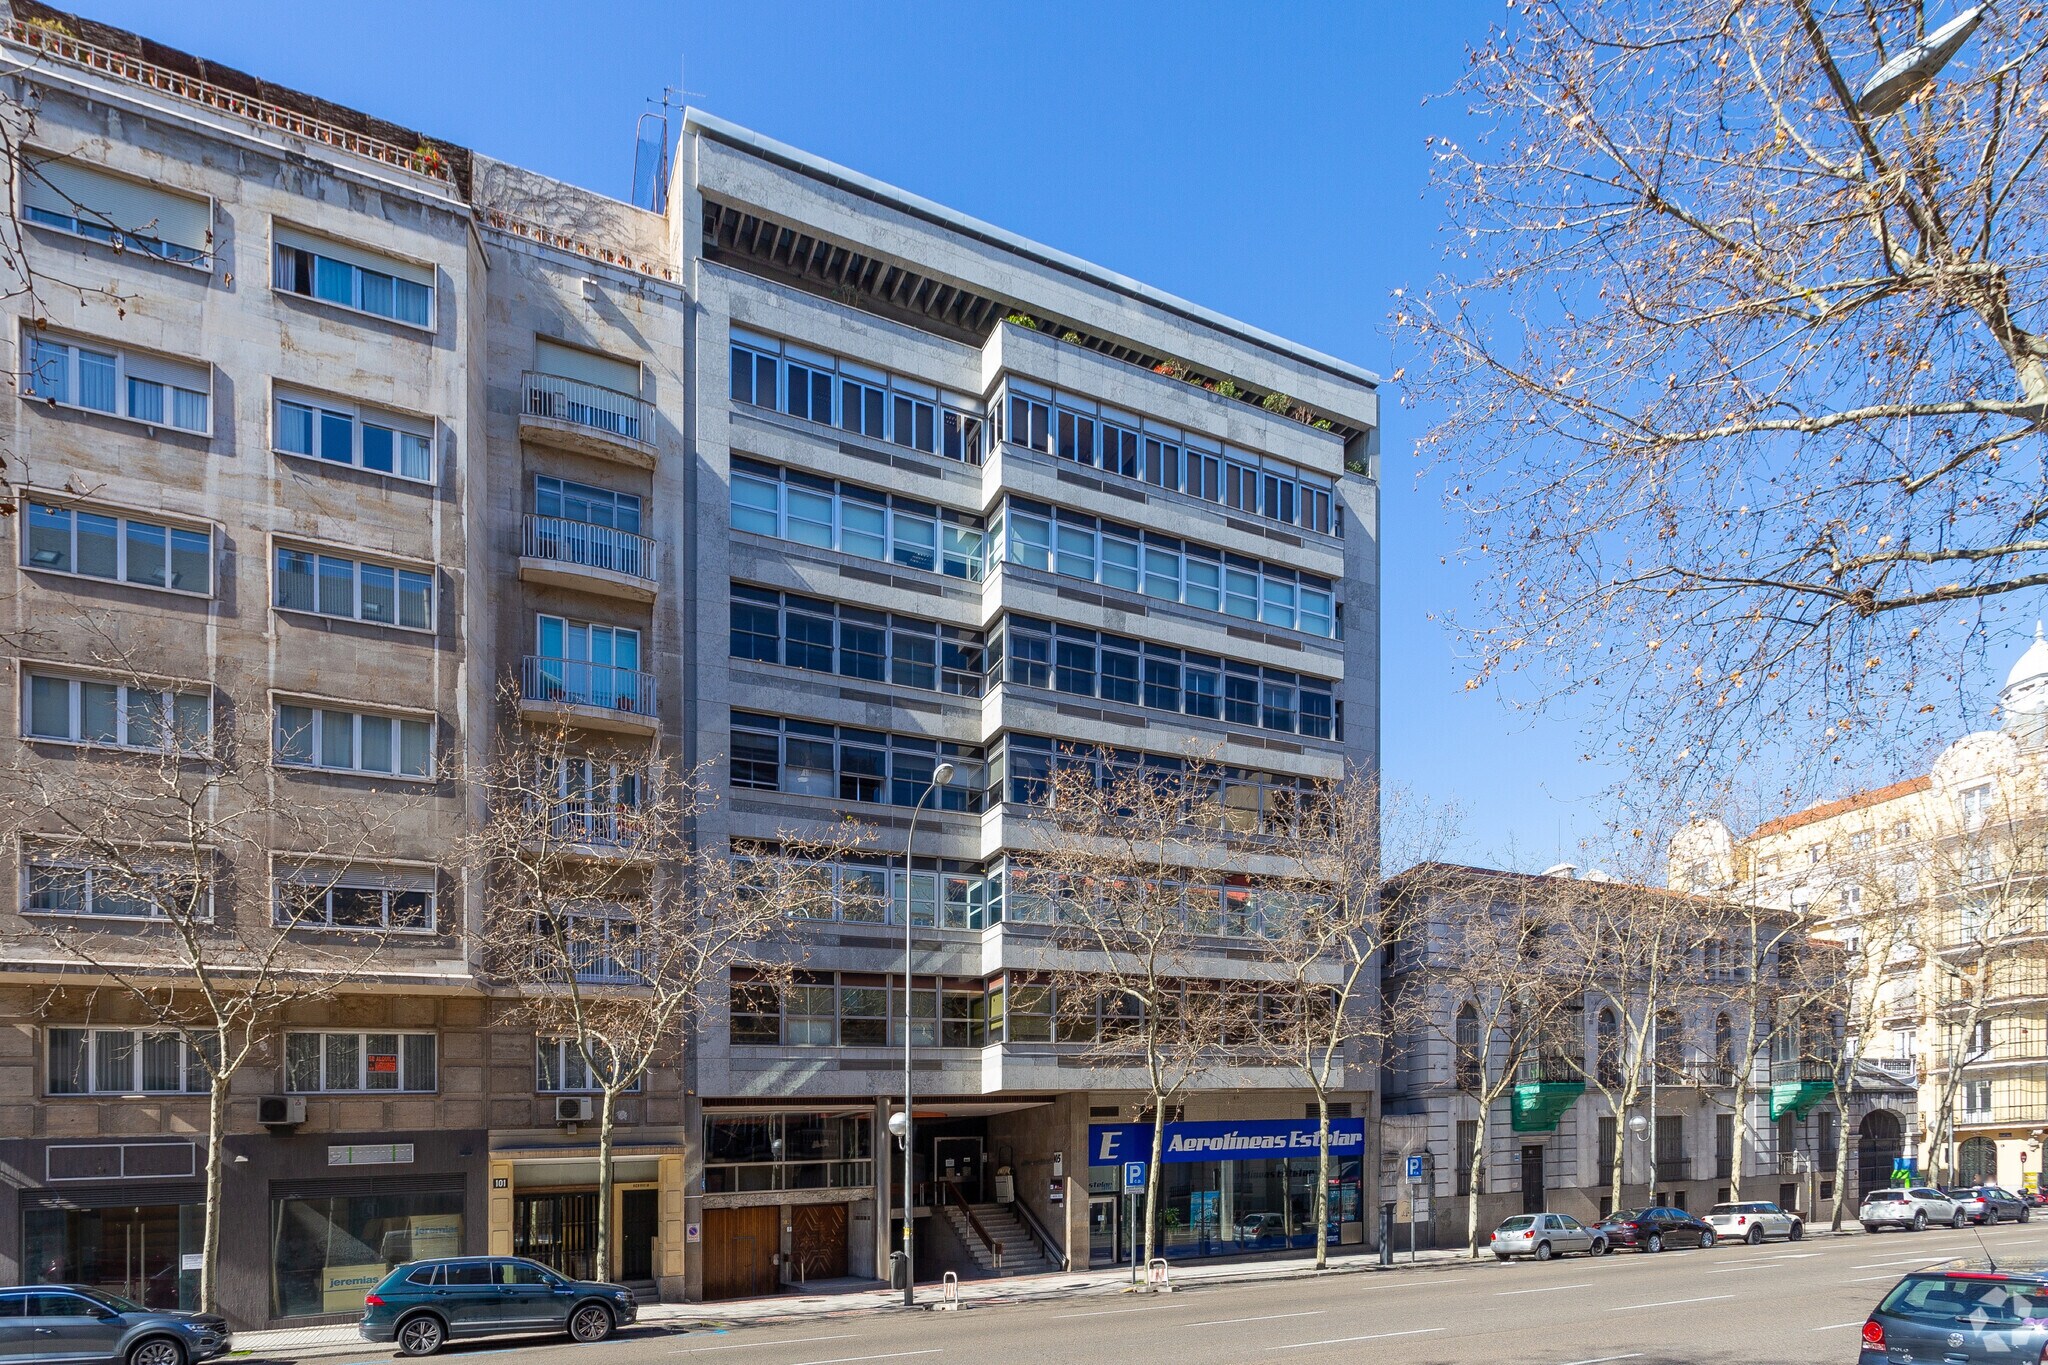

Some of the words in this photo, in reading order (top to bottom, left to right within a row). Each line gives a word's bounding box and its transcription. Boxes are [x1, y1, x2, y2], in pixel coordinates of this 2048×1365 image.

[1099, 1131, 1123, 1160] E
[1167, 1130, 1287, 1152] Aerolíneas
[1129, 1165, 1142, 1184] P
[1409, 1158, 1419, 1175] P
[494, 1179, 507, 1188] 101
[415, 1225, 459, 1236] jeremias
[329, 1275, 379, 1288] jeremias
